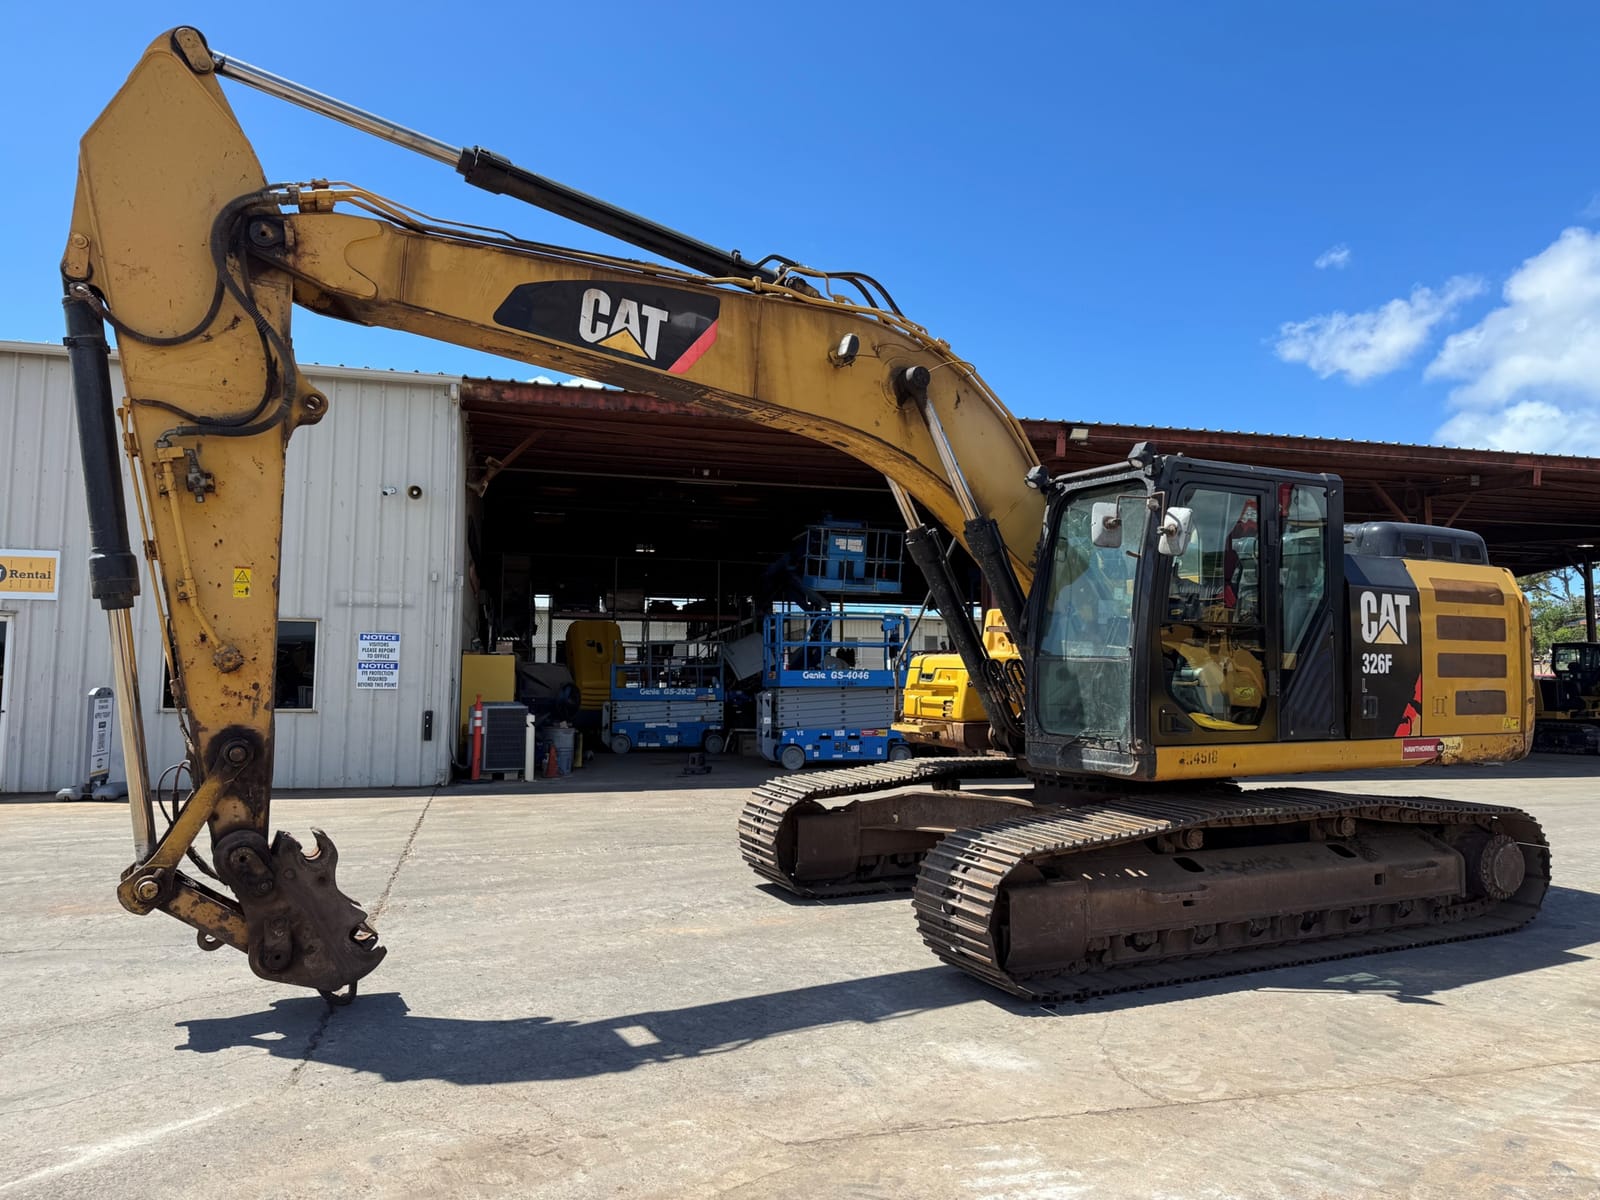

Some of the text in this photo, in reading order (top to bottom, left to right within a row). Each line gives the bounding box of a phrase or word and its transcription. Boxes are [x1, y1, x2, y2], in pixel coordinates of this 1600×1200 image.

[579, 288, 669, 361] CAT
[9, 569, 52, 580] Rental
[1360, 591, 1411, 645] CAT
[1362, 653, 1393, 674] 326F
[803, 671, 870, 680] Genie GS-4046
[640, 688, 661, 696] Genie
[1404, 744, 1436, 753] HAWTHORNE
